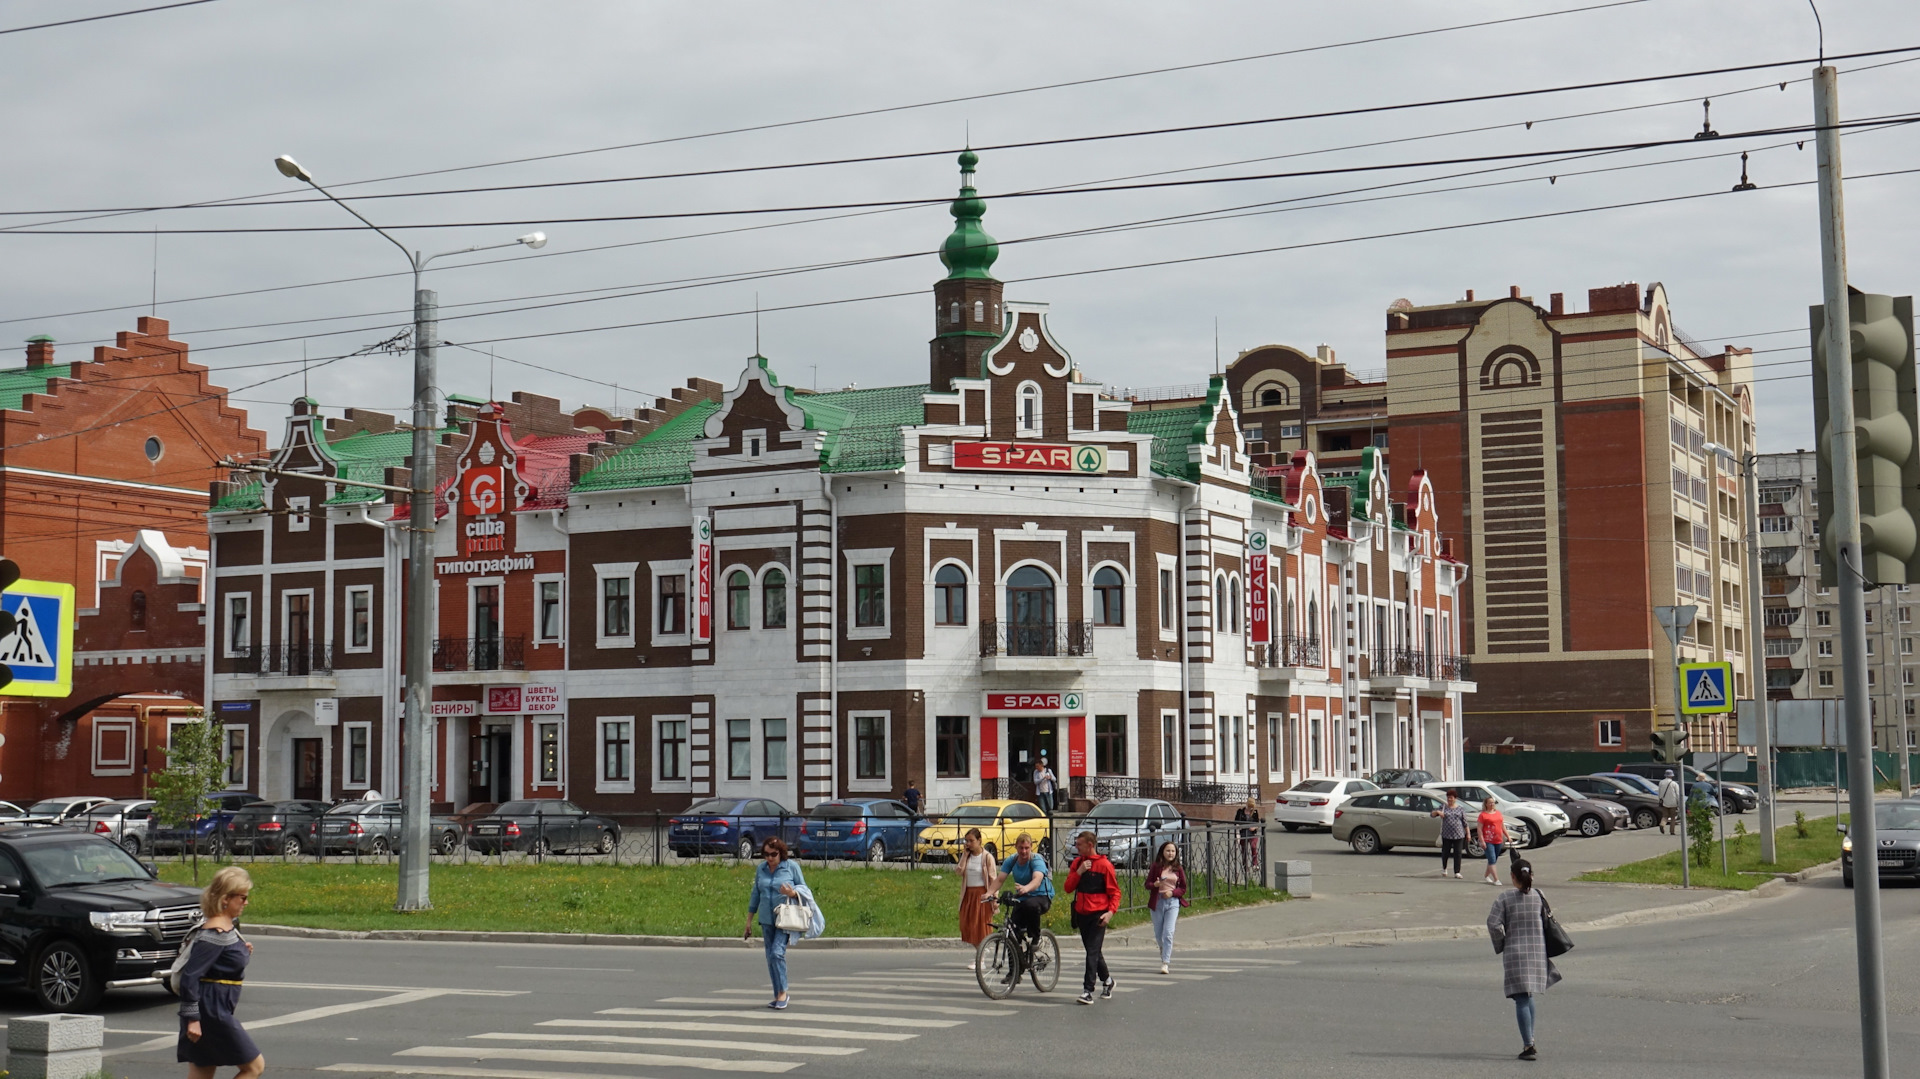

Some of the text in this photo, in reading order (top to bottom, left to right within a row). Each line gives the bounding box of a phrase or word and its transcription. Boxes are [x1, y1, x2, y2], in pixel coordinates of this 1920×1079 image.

[982, 447, 1070, 466] SPAR
[466, 516, 505, 536] cuba
[466, 534, 504, 557] print
[437, 554, 534, 576] типографий
[701, 546, 709, 616] SPAR
[1253, 556, 1265, 622] SPAR
[1004, 696, 1059, 707] SPAR
